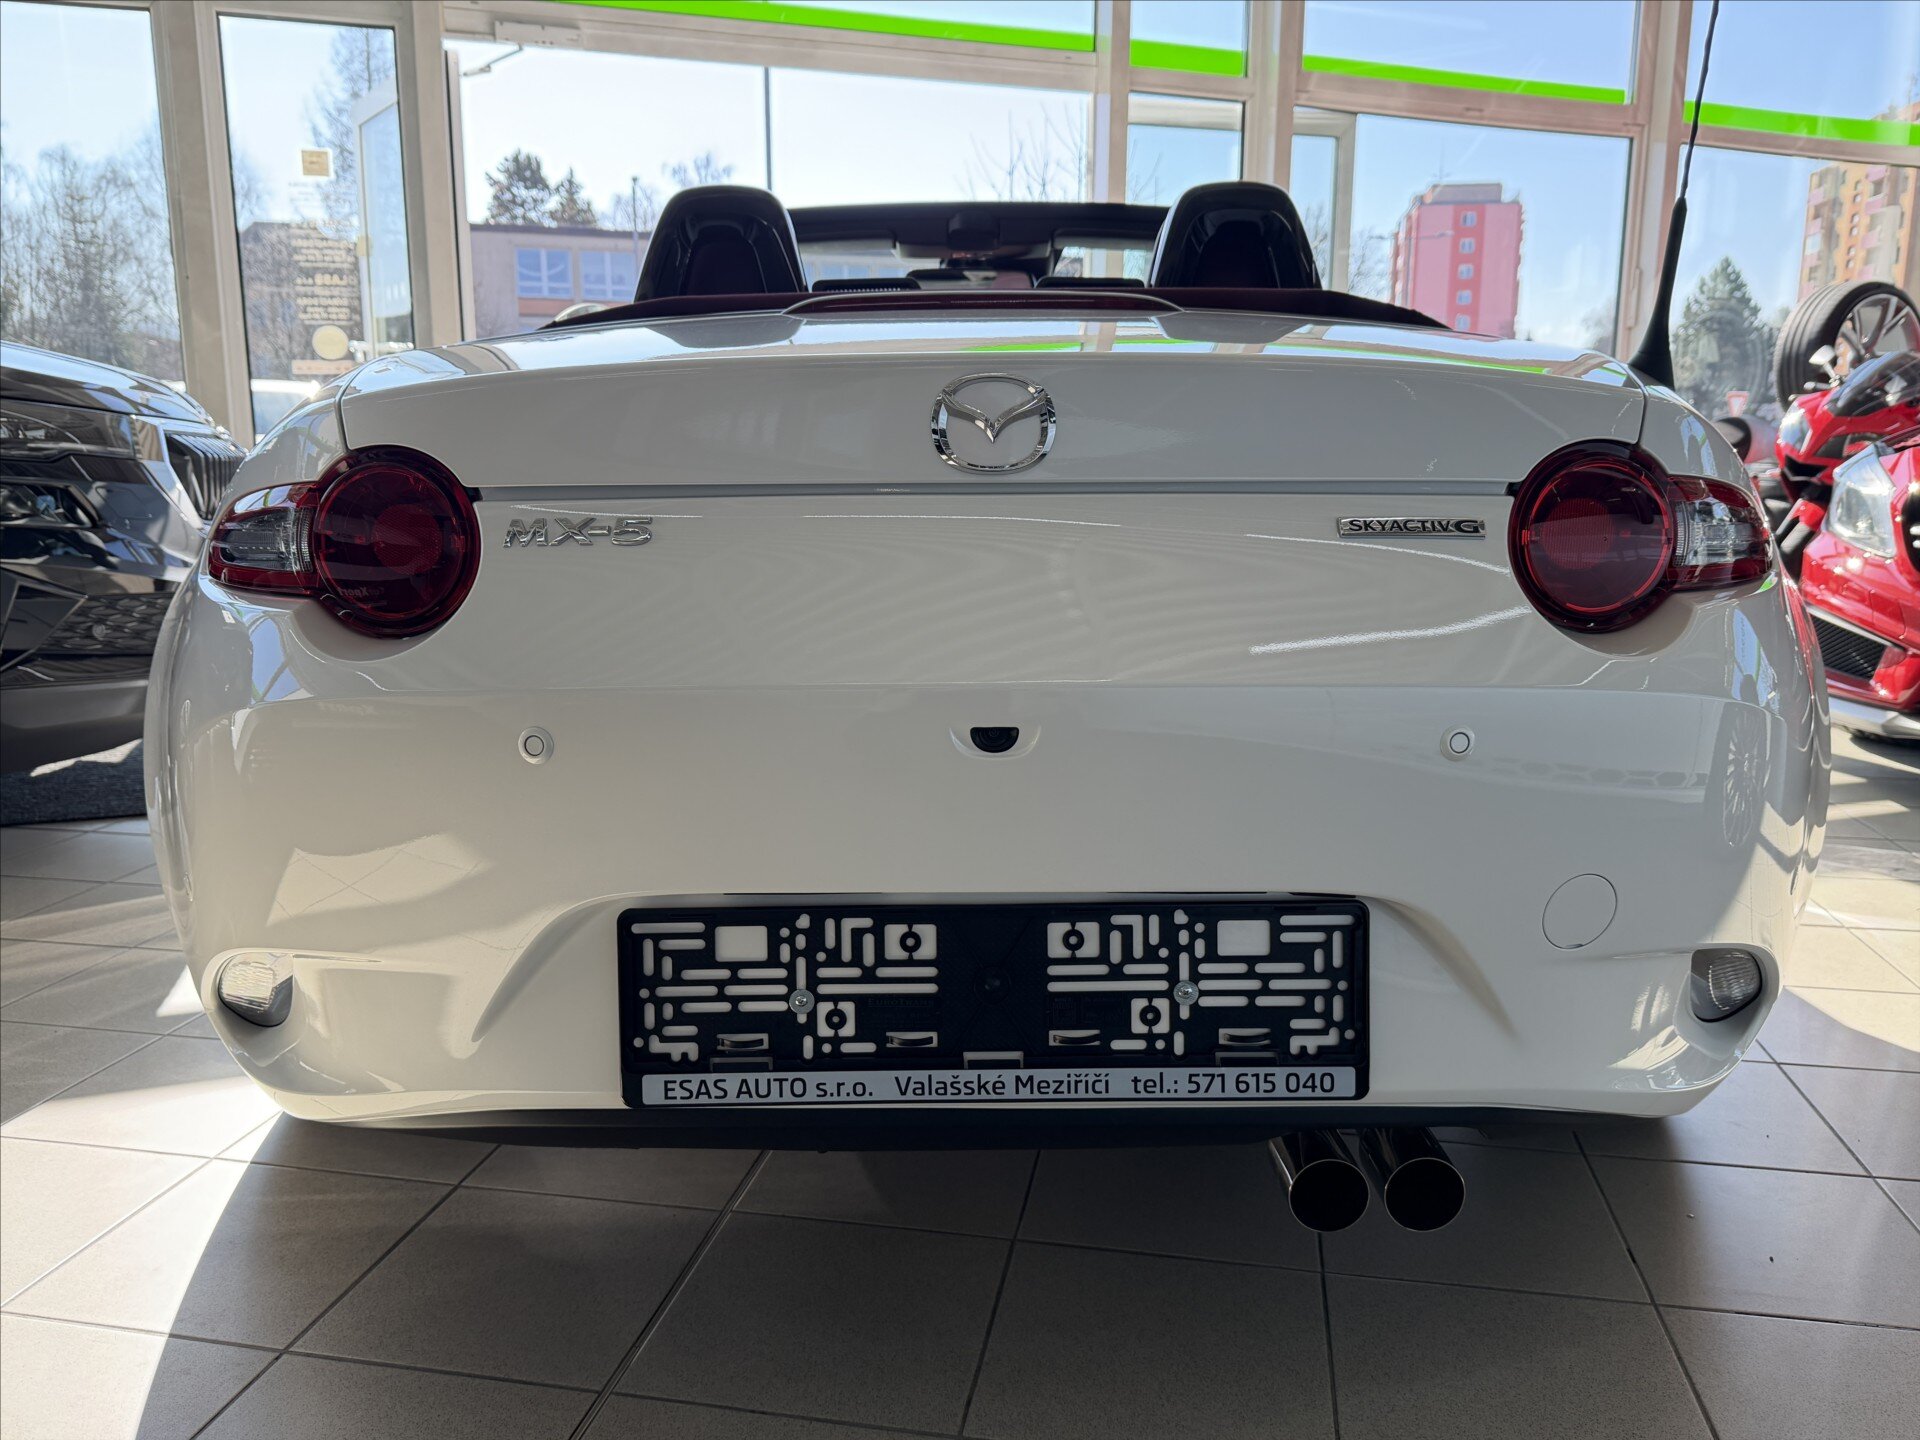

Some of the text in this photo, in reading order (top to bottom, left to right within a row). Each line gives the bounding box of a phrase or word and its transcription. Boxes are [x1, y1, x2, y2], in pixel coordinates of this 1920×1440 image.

[503, 516, 653, 548] MX-5
[664, 1072, 1335, 1100] ESAS AUTO s.r.o. Valašské Meziříčí tel.: 571 615 040
